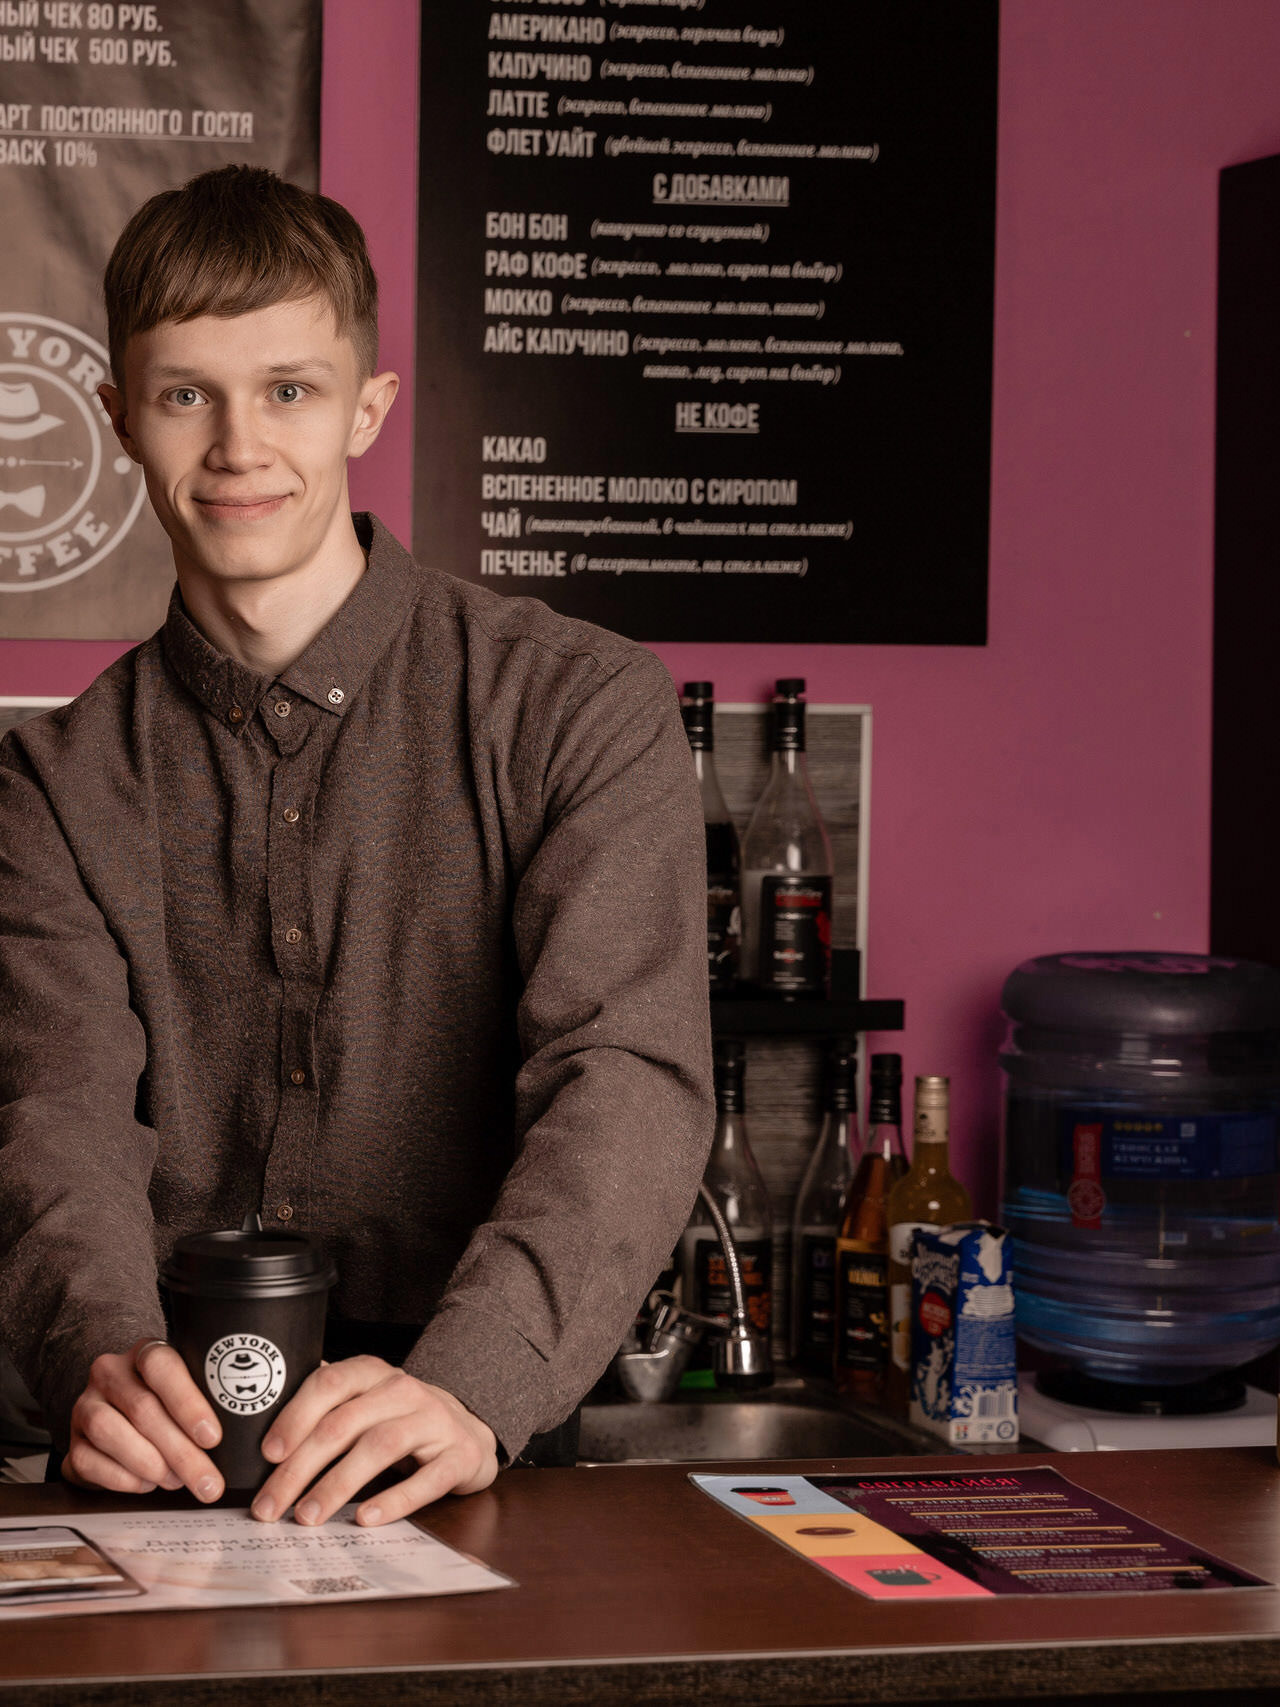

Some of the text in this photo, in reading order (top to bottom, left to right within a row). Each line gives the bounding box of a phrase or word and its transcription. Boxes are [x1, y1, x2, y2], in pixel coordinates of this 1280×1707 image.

[45, 3, 82, 29] ЧЕК
[87, 4, 114, 30] 80
[118, 5, 163, 33] РУБ.
[488, 13, 606, 44] АМЕРИКАНО
[40, 35, 79, 63] ЧЕК
[89, 37, 127, 64] 500
[132, 40, 177, 66] РУБ.
[487, 51, 592, 81] КАПУЧИНО
[487, 89, 549, 118] ЛАТТЕ
[40, 106, 182, 135] ПОСТОЯННОГО
[191, 110, 253, 137] ГОСТЯ
[54, 141, 97, 167] 10%
[487, 127, 597, 158] ФЛЕТ УАЙТ
[653, 173, 789, 202] С ДОБАВКАМИ
[486, 212, 524, 239] БОН
[528, 213, 568, 240] БОН
[485, 250, 588, 279] РАФ КОФЕ
[485, 289, 553, 316] МОККО
[484, 322, 629, 356] АЙС КАПУЧИНО
[675, 402, 759, 429] НЕ КОФЕ
[482, 436, 547, 463] КАКАО
[482, 474, 797, 506] ВСПЕНЕННОЕ МОЛОКО С СИРОПОМ
[481, 508, 519, 538] ЧАЙ
[481, 550, 567, 576] ПЕЧЕНЬЕ
[209, 1336, 280, 1365] NEW YORK
[218, 1388, 278, 1412] COFFEE
